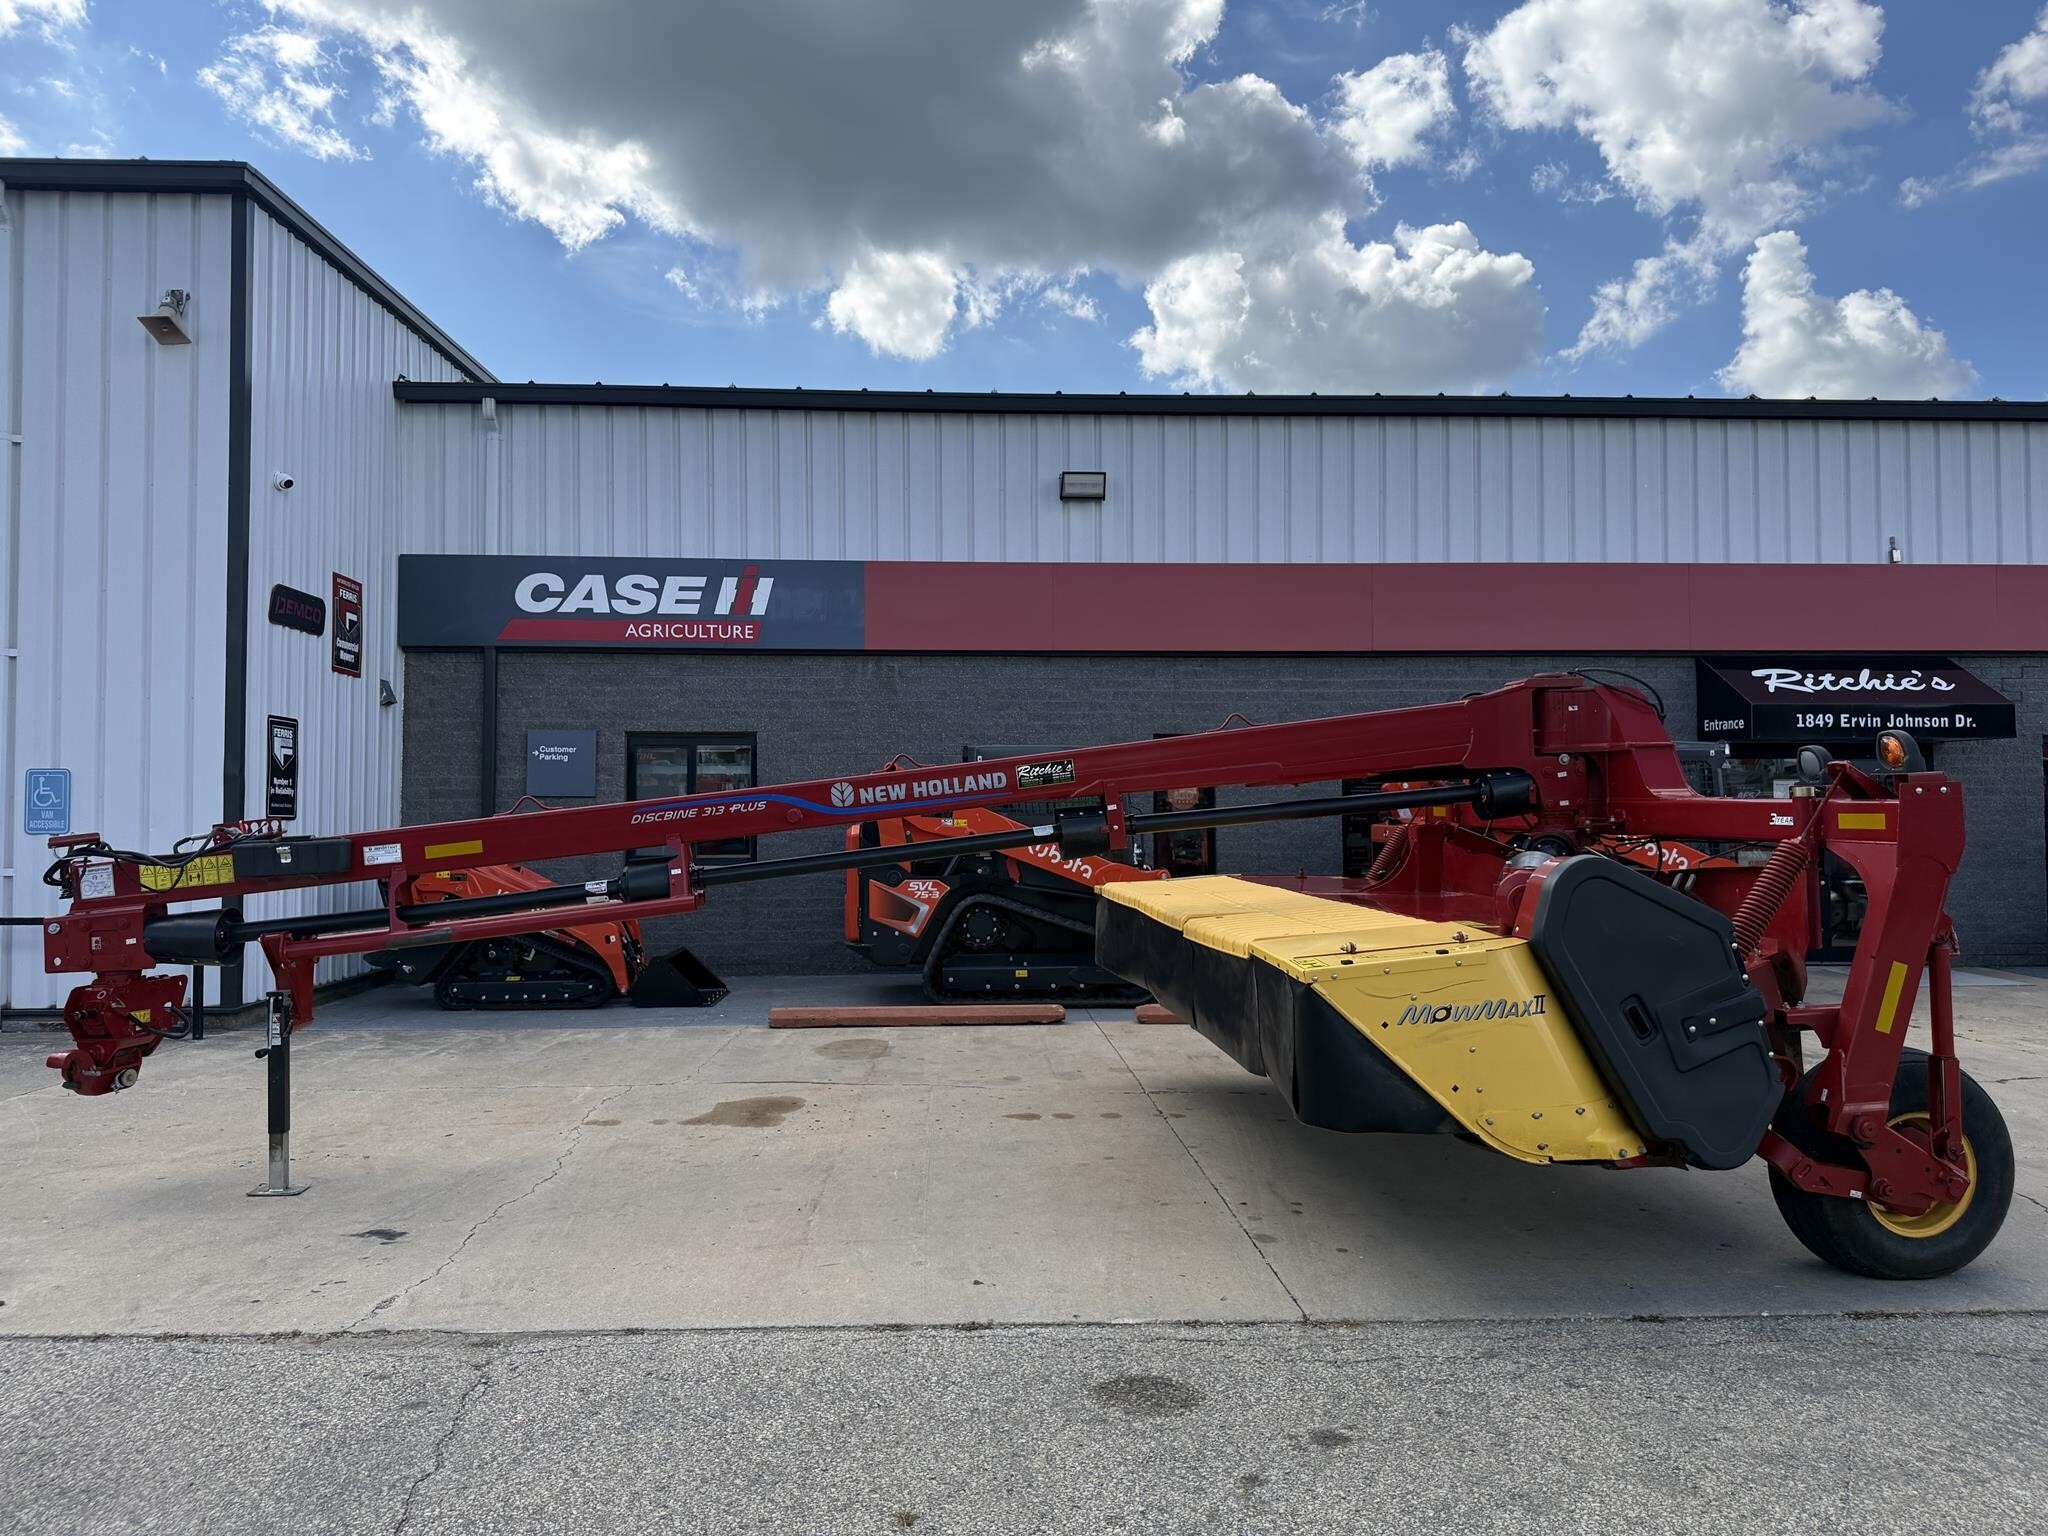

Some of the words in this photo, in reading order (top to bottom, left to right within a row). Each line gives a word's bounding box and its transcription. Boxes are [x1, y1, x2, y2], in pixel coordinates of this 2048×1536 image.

[340, 588, 358, 603] FERRIS
[515, 572, 708, 615] CASE
[276, 597, 322, 622] DEMCO
[625, 623, 754, 639] AGRICULTURE
[1751, 668, 1955, 693] Ritchie's
[1703, 719, 1745, 732] Entrance
[1796, 713, 1834, 728] 1849
[1840, 713, 1881, 728] Ervin
[1886, 713, 1949, 729] Johnson
[1955, 713, 1977, 728] Dr.
[273, 728, 293, 739] FERRIS
[539, 753, 568, 762] Parking
[859, 783, 907, 804] NEW
[912, 771, 1007, 798] HOLLAND
[41, 809, 54, 819] VAN
[631, 807, 698, 825] DISCBINE
[701, 805, 725, 817] 313
[908, 881, 938, 891] SVL
[913, 891, 940, 899] 75-3
